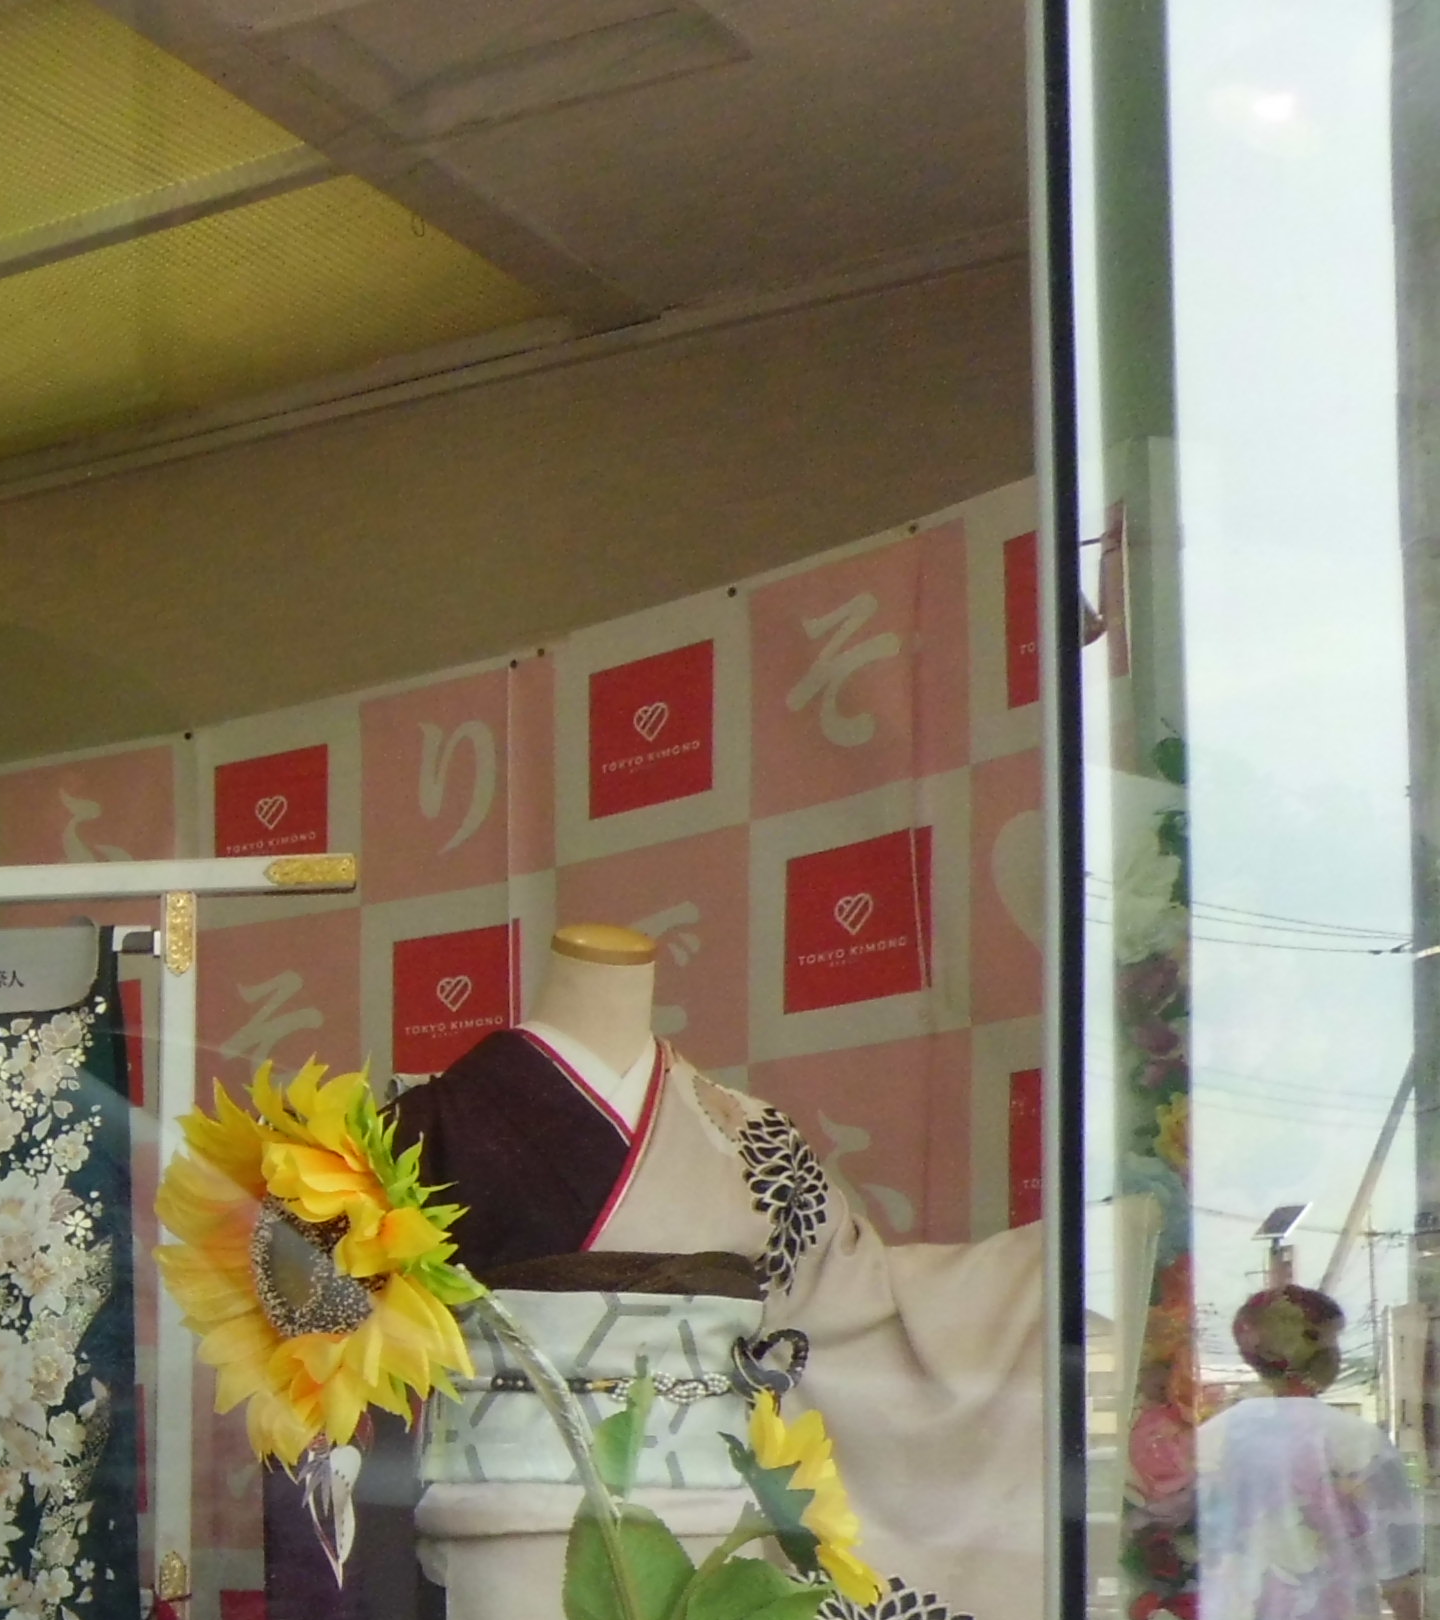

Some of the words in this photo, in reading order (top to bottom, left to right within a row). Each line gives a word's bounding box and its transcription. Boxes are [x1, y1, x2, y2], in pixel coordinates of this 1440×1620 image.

[417, 719, 497, 856] り
[797, 948, 846, 967] TOKYO
[404, 1022, 447, 1036] TOKYO
[449, 1015, 504, 1031] KIMONO
